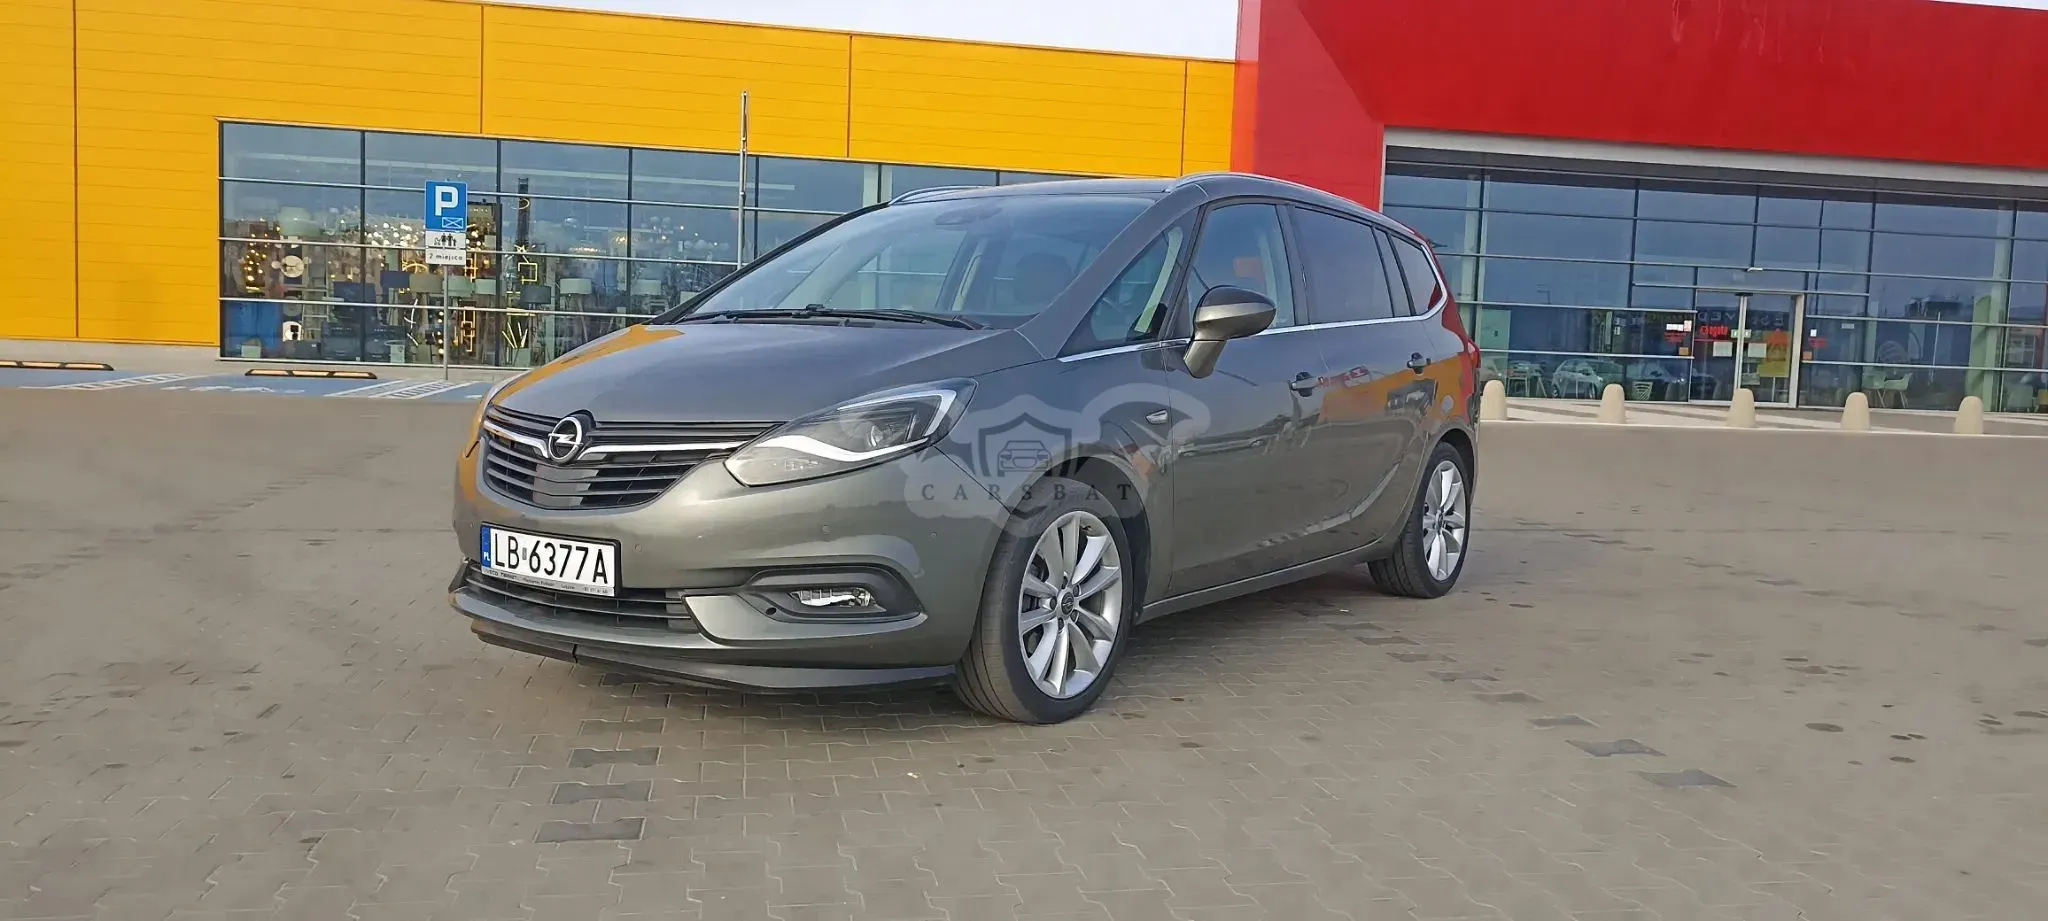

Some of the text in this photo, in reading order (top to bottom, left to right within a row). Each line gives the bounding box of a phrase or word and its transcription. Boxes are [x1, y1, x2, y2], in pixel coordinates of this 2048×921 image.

[435, 186, 459, 216] P
[483, 552, 491, 562] PL
[495, 533, 520, 569] LB
[529, 540, 608, 585] 6377A
